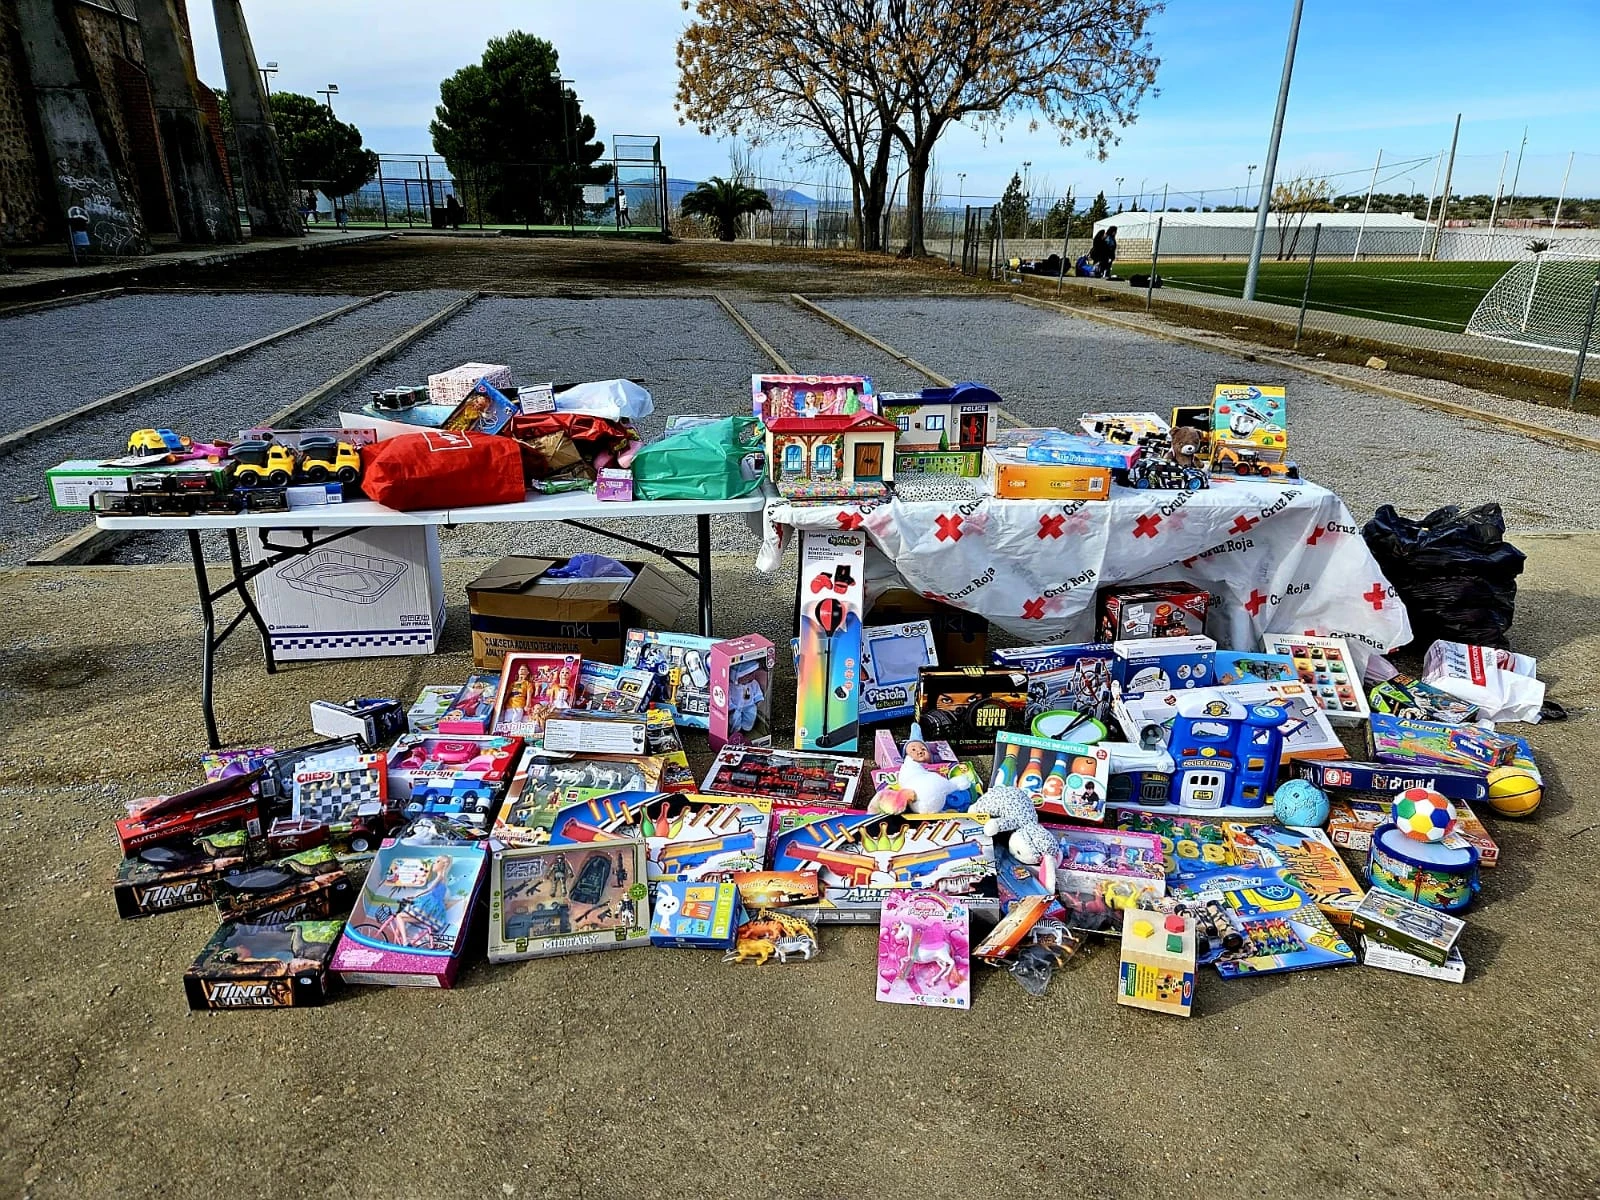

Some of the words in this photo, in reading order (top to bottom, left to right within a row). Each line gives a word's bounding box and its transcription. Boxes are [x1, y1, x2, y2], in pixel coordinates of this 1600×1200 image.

[1261, 499, 1287, 518] Cruz
[1327, 521, 1356, 535] Cruz
[1226, 537, 1254, 552] Roja
[948, 584, 975, 600] Cruz
[973, 566, 996, 588] Roja
[1044, 581, 1071, 599] Cruz
[1071, 568, 1096, 588] Roja
[1286, 582, 1311, 595] Roja
[1358, 635, 1384, 650] Roja
[867, 687, 906, 702] Pistola
[977, 708, 1006, 717] SQUAD
[977, 717, 1006, 727] SEVEN
[1183, 759, 1204, 767] POLICE
[1206, 760, 1232, 769] STATION
[297, 771, 332, 783] CHESS
[1025, 775, 1042, 794] 2
[1044, 776, 1063, 796] 3
[848, 887, 878, 898] AIR
[543, 934, 600, 950] MILITARY
